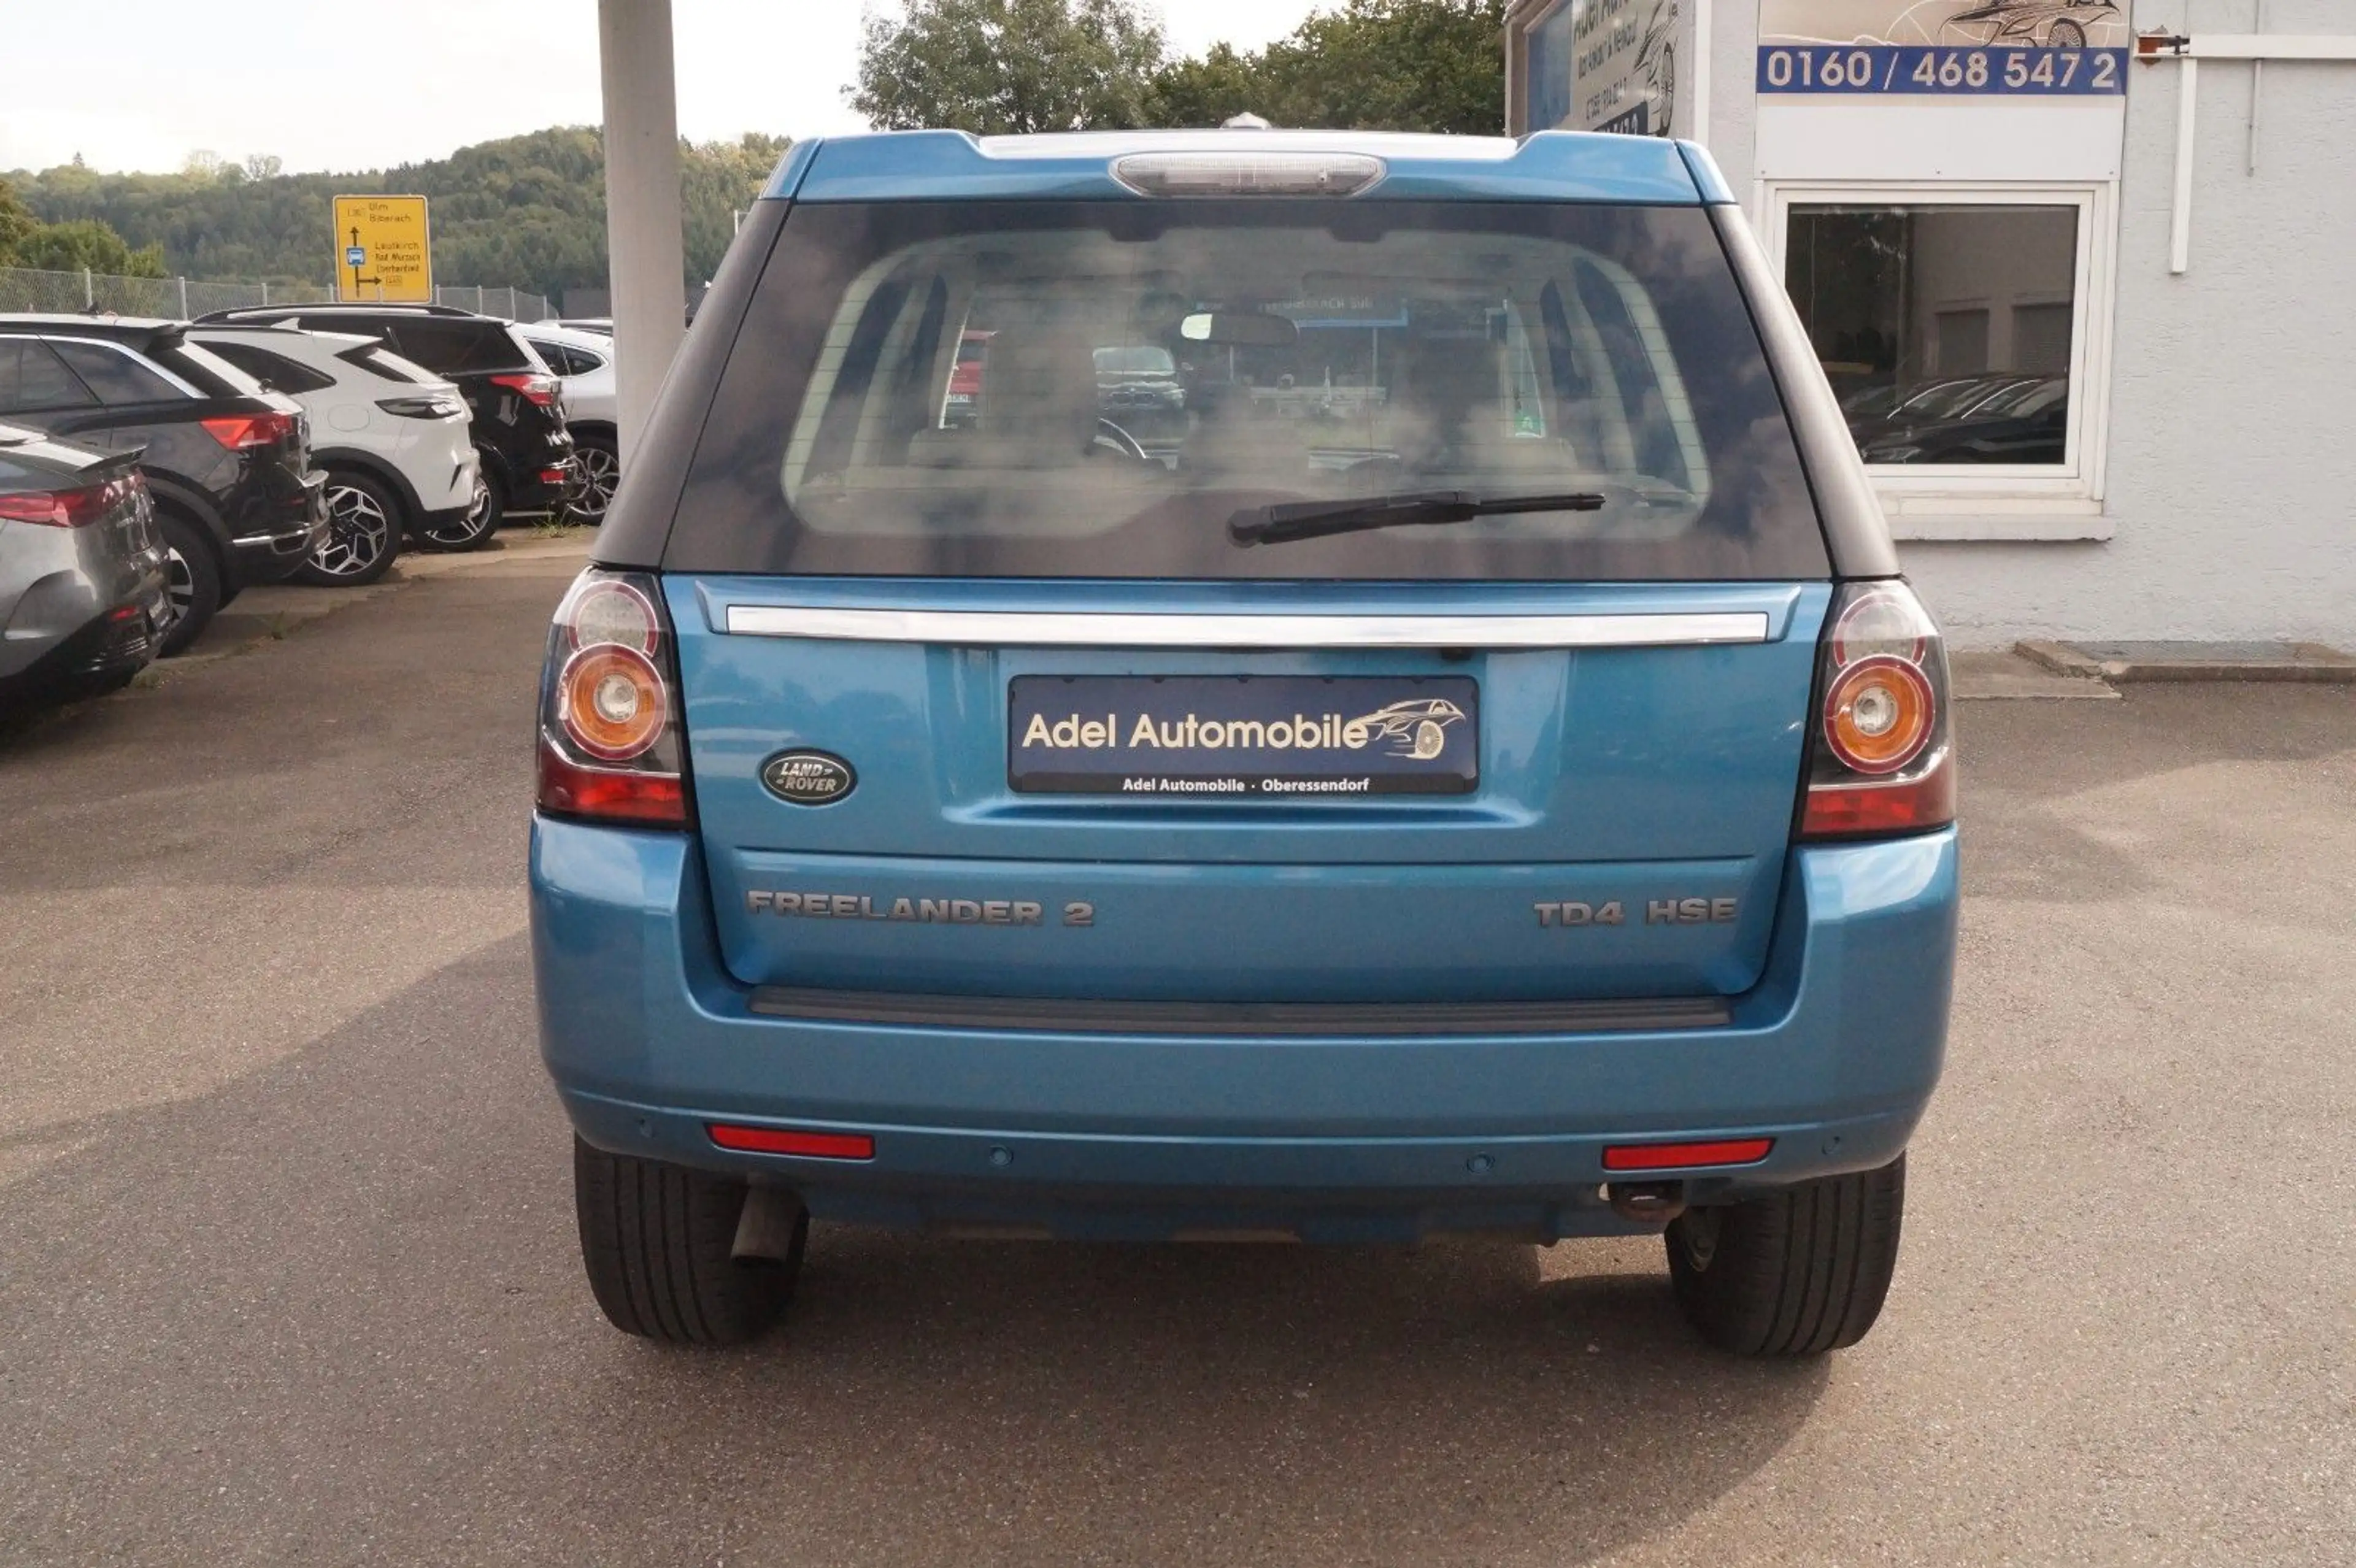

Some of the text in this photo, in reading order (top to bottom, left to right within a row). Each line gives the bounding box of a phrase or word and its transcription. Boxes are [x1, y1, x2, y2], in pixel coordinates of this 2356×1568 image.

[1767, 51, 1872, 86] 0160
[1912, 52, 1989, 87] 468
[1022, 713, 1369, 749] Adel Automobile
[780, 763, 823, 777] LAND
[785, 775, 837, 791] ROVER
[1123, 777, 1370, 792] Adel Automobile Oberessendorf
[747, 890, 1094, 927] FREELANDER 2
[1534, 897, 1738, 926] TD4 HSE
